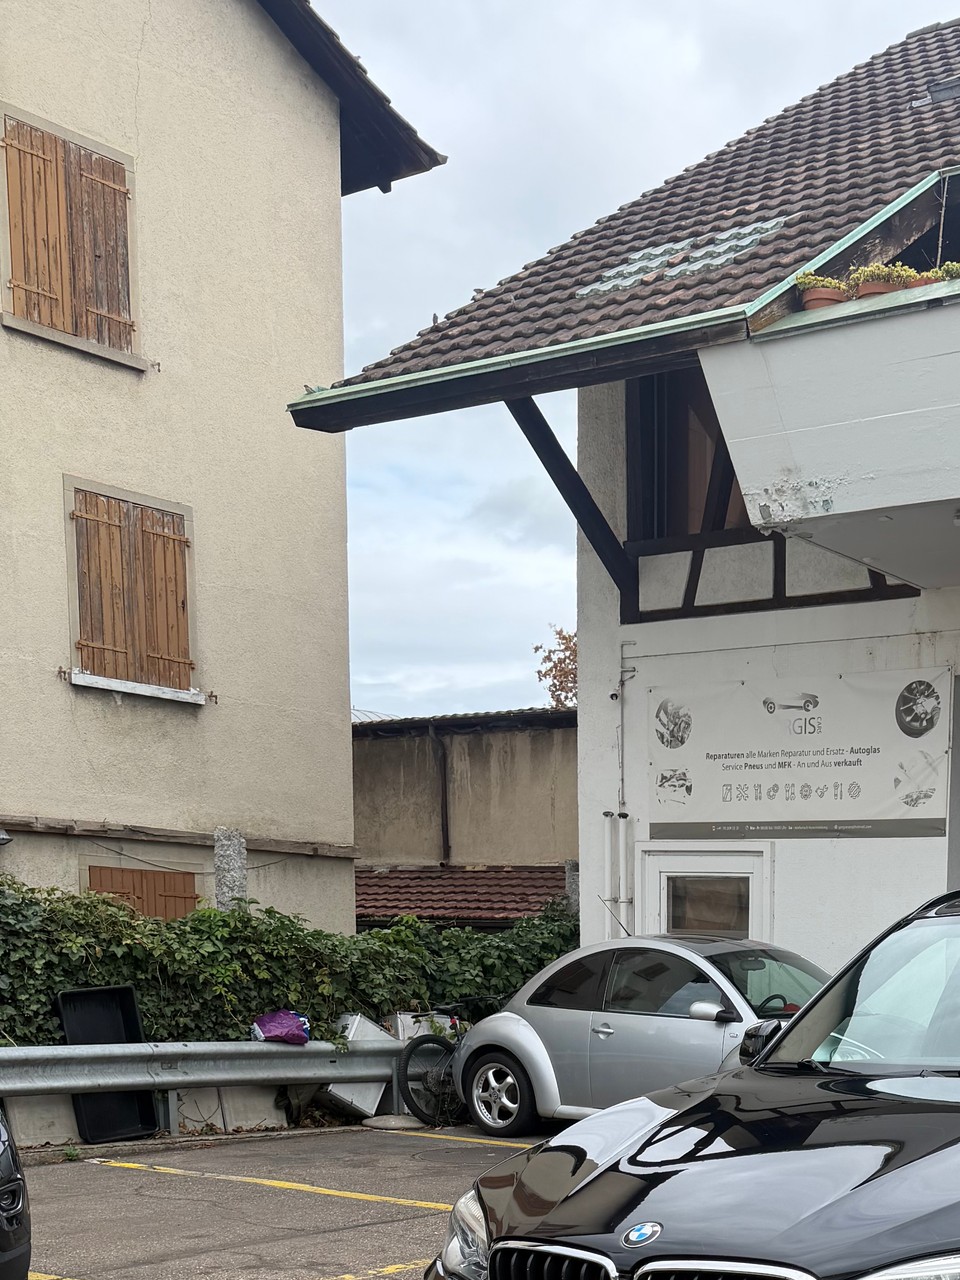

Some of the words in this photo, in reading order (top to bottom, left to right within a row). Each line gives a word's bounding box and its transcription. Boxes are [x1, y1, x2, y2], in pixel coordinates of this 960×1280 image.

[705, 752, 745, 762] Reparaturen
[745, 750, 756, 758] alle
[757, 750, 779, 758] Marken
[780, 749, 811, 760] Reparatur
[812, 747, 825, 756] und
[825, 747, 845, 756] Ersatz
[849, 745, 881, 756] Autoglas
[721, 763, 743, 771] Service
[743, 762, 763, 770] Pneus
[764, 761, 776, 769] und
[777, 761, 792, 769] MFK
[806, 760, 820, 768] und
[820, 759, 833, 768] Aus
[833, 758, 863, 767] verkauft
